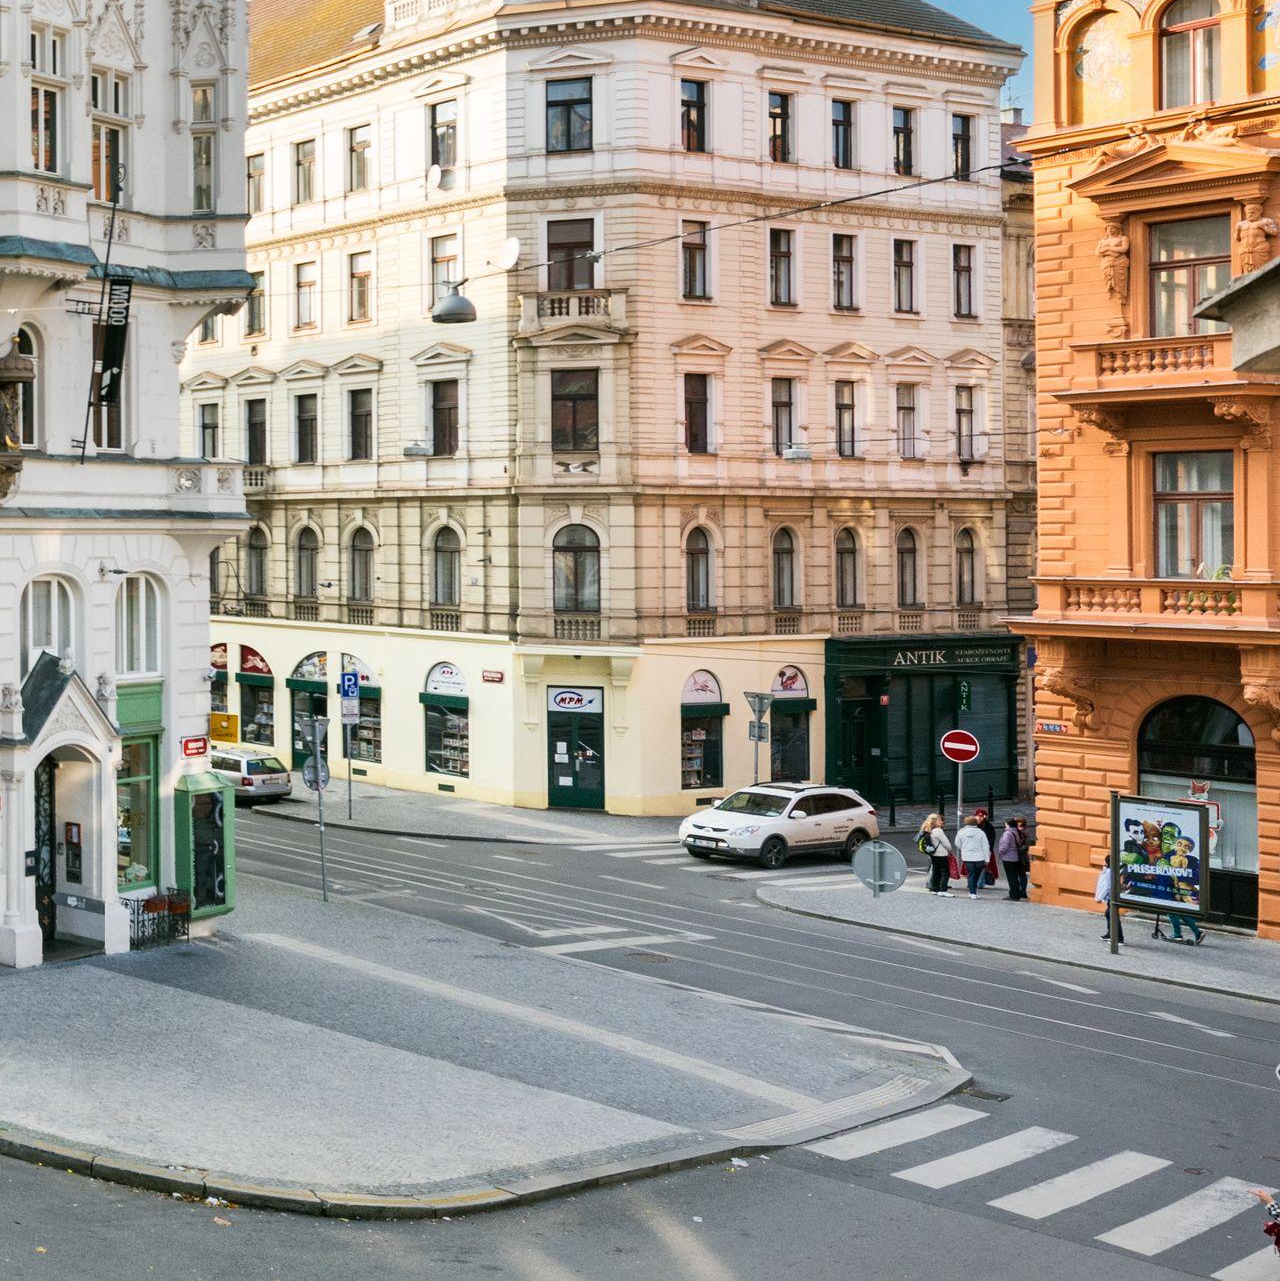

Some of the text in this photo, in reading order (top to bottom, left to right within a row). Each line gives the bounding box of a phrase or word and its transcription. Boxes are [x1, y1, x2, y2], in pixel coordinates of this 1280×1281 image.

[893, 650, 947, 666] ANTIK
[344, 675, 355, 690] P
[558, 697, 583, 705] MPM
[960, 681, 968, 711] ANTIK
